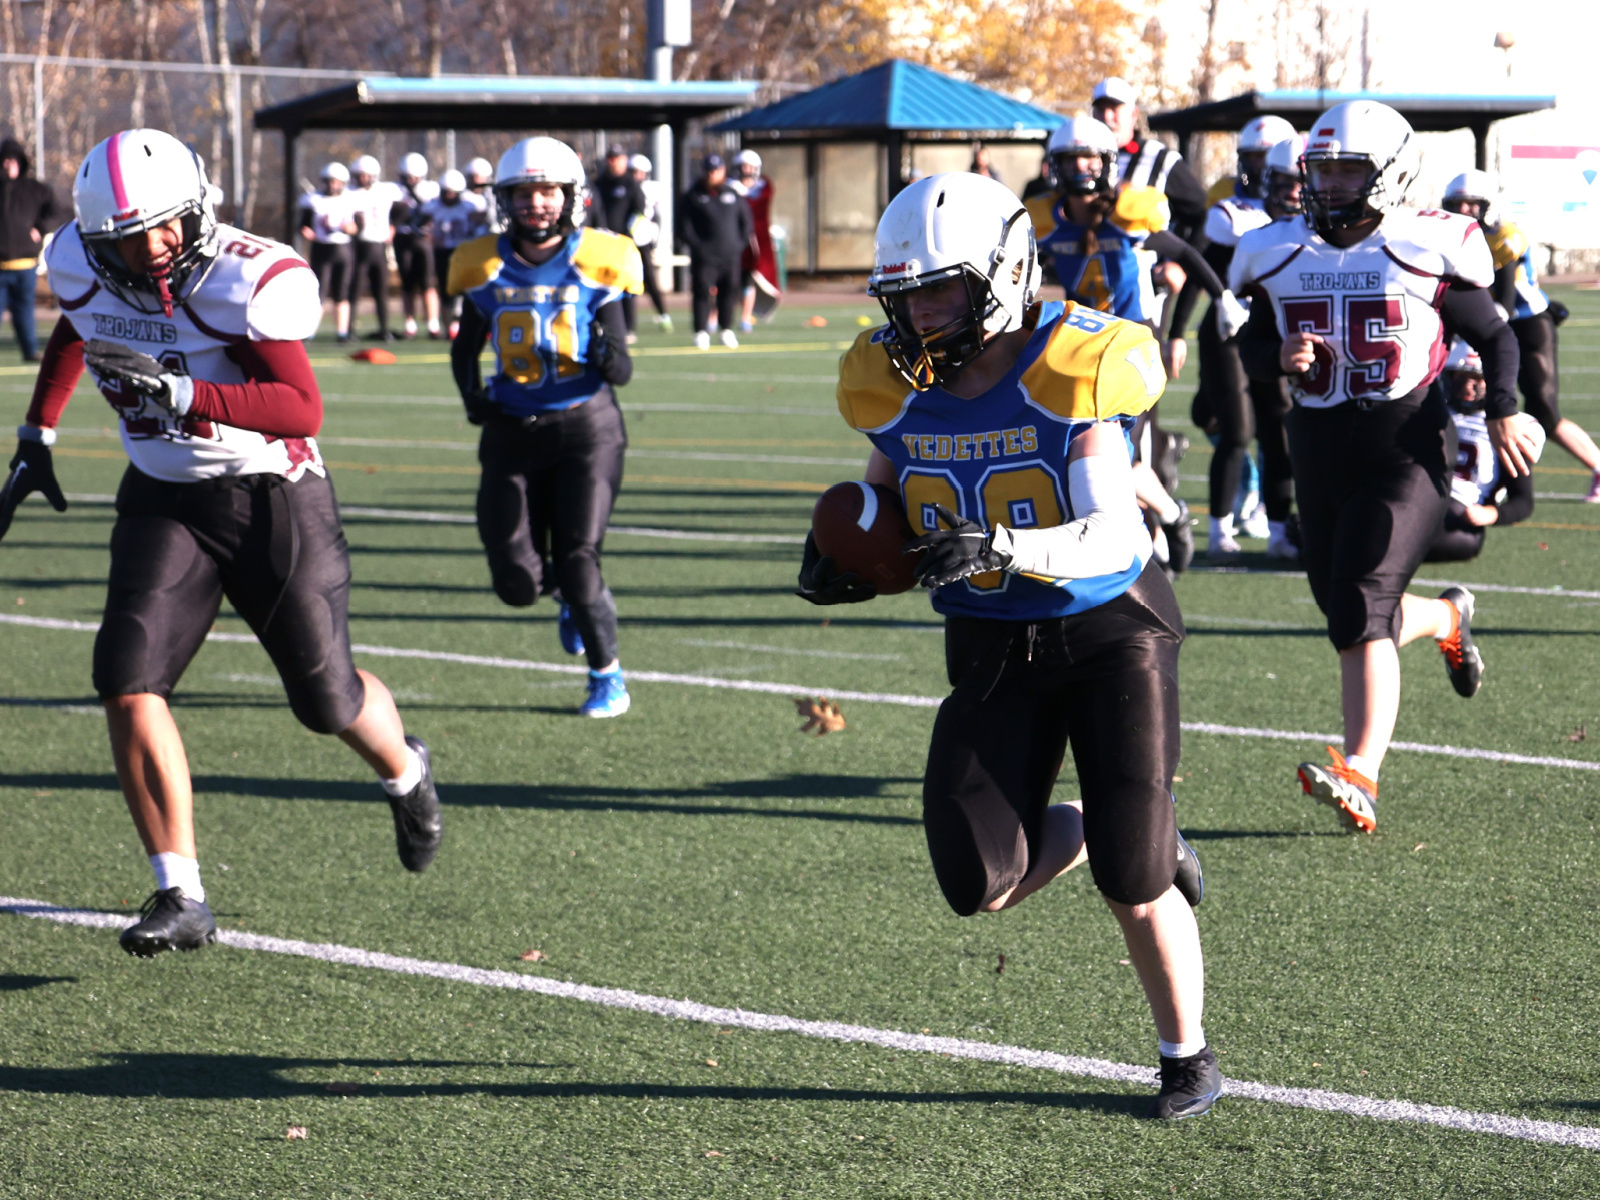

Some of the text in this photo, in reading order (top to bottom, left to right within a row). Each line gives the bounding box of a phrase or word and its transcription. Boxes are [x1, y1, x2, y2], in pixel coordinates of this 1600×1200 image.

[1071, 253, 1116, 314] 4
[1300, 271, 1381, 291] TROJANS
[92, 312, 177, 344] TROJANS
[492, 303, 586, 390] 81
[1279, 294, 1409, 401] 55
[902, 425, 1039, 461] VEDETTES
